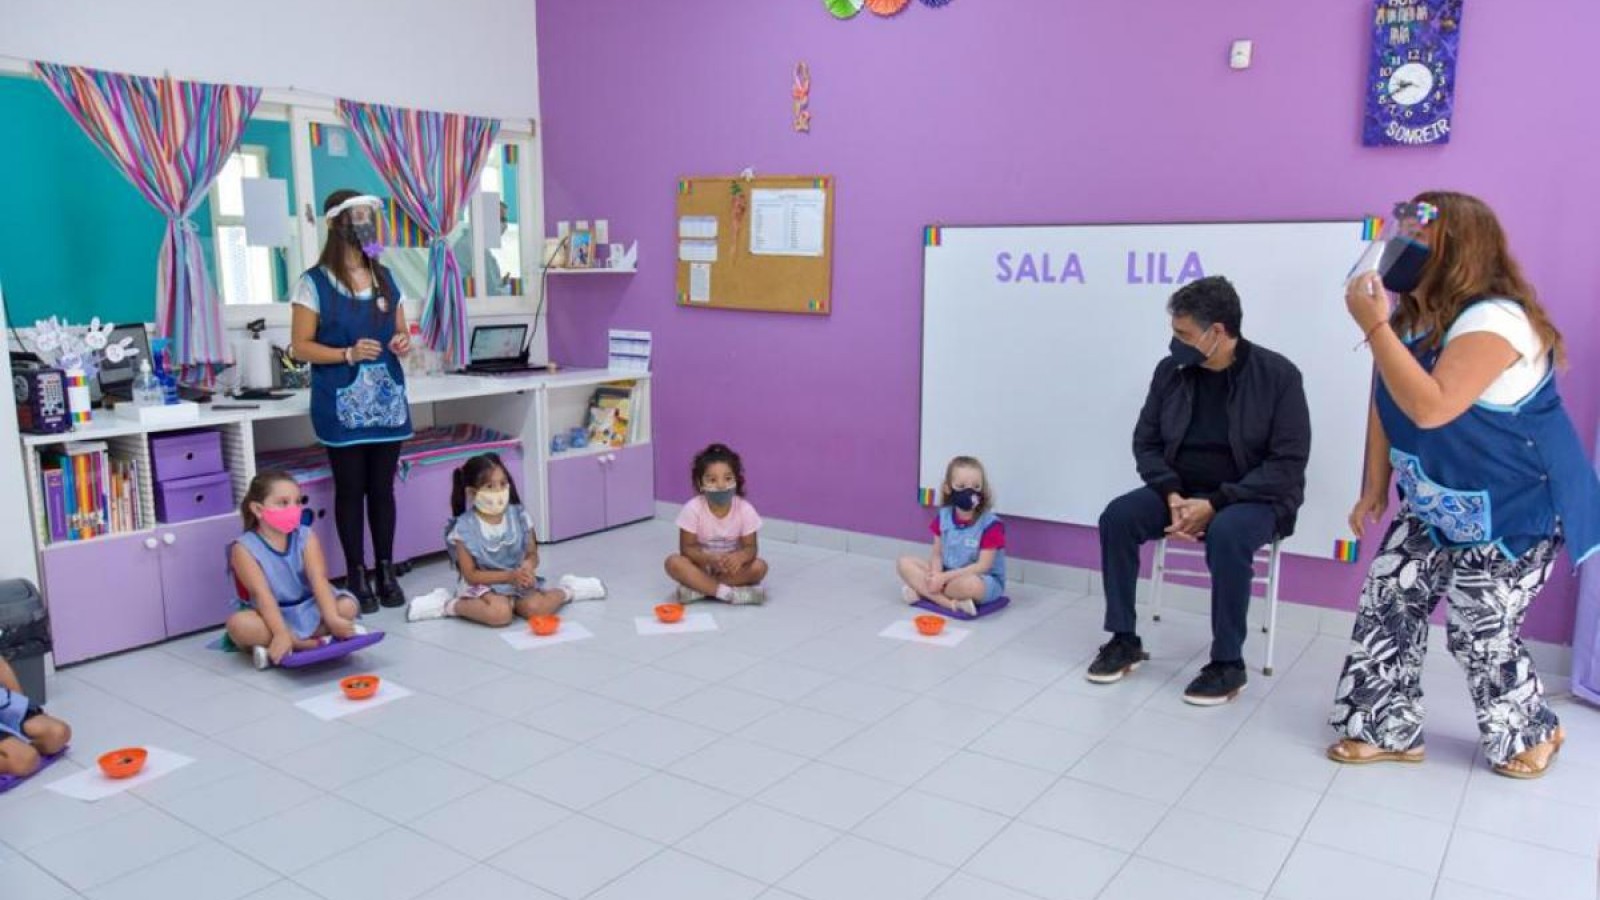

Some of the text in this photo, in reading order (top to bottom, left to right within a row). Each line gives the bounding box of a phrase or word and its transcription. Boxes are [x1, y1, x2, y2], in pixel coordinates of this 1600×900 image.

[1380, 67, 1392, 77] 10
[1422, 103, 1430, 113] 5
[996, 251, 1205, 284] SALA LILA
